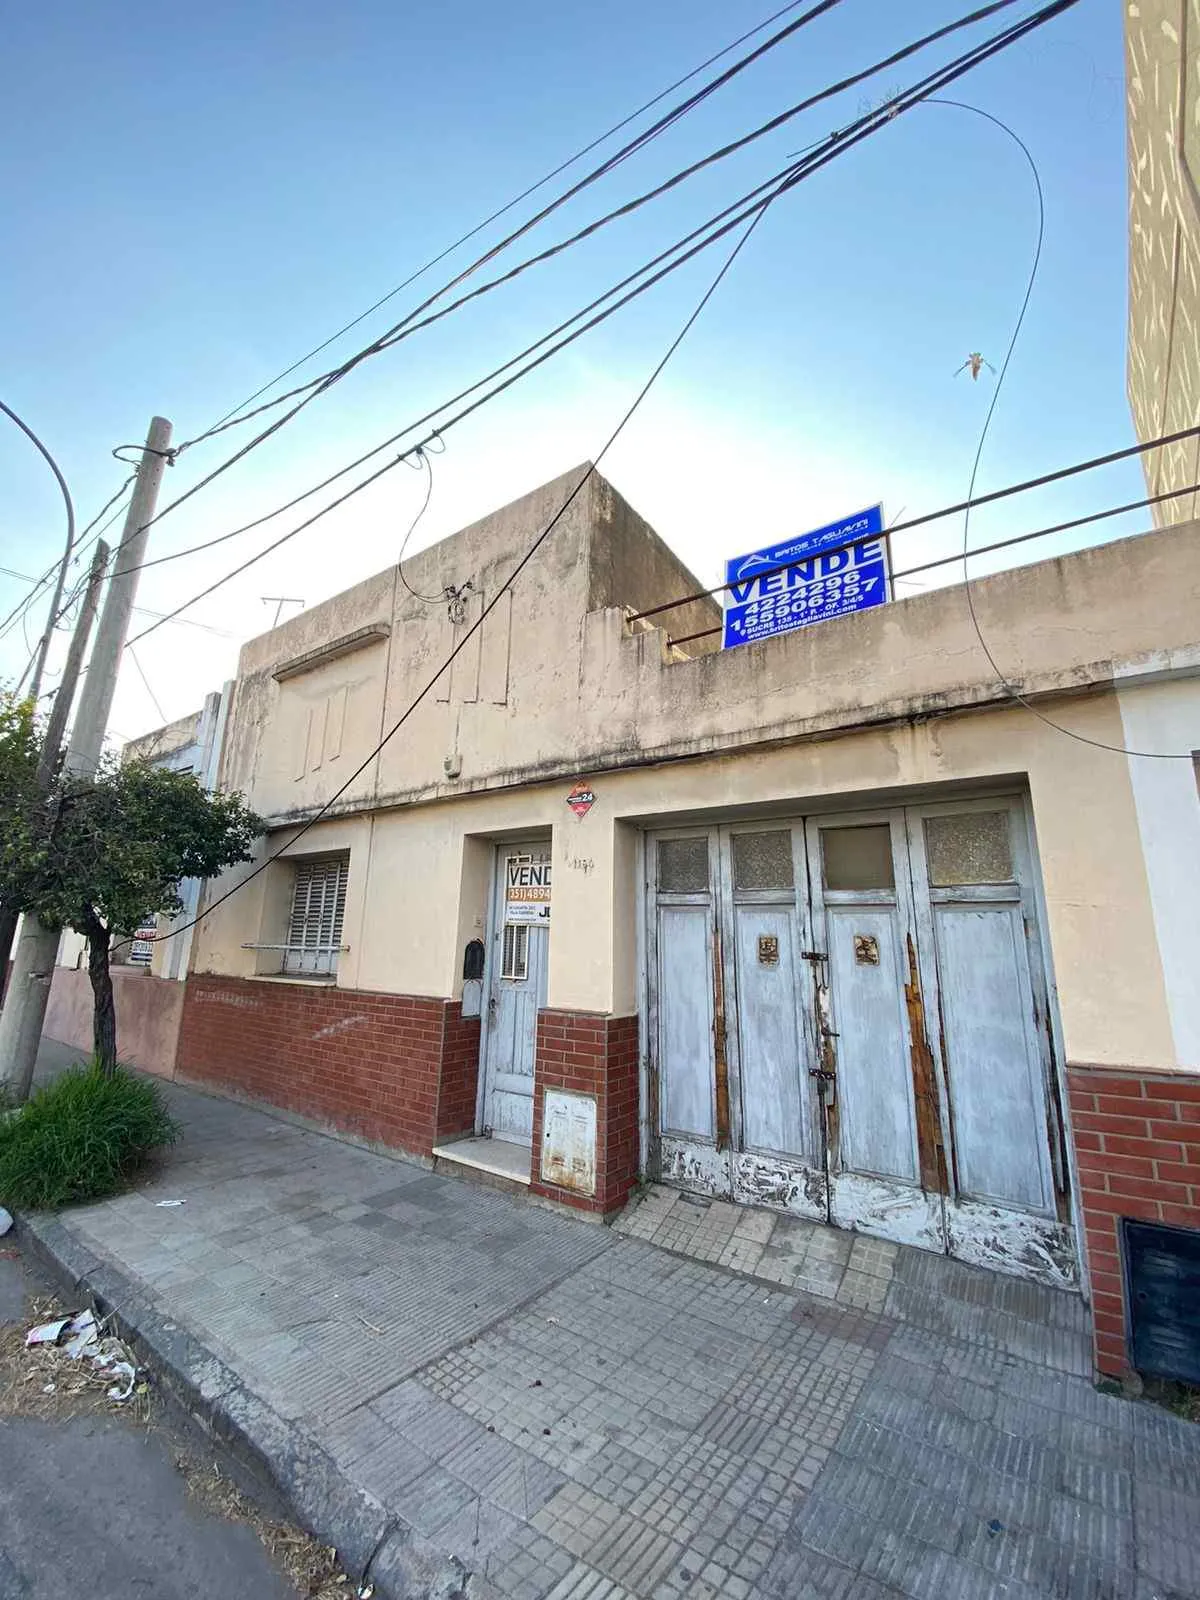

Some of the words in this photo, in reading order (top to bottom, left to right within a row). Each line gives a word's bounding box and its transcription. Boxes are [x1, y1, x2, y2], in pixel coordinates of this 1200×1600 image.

[727, 540, 883, 604] VENDE
[744, 570, 861, 615] 4224296
[730, 577, 880, 632] 155906357
[746, 621, 775, 635] SUCRE
